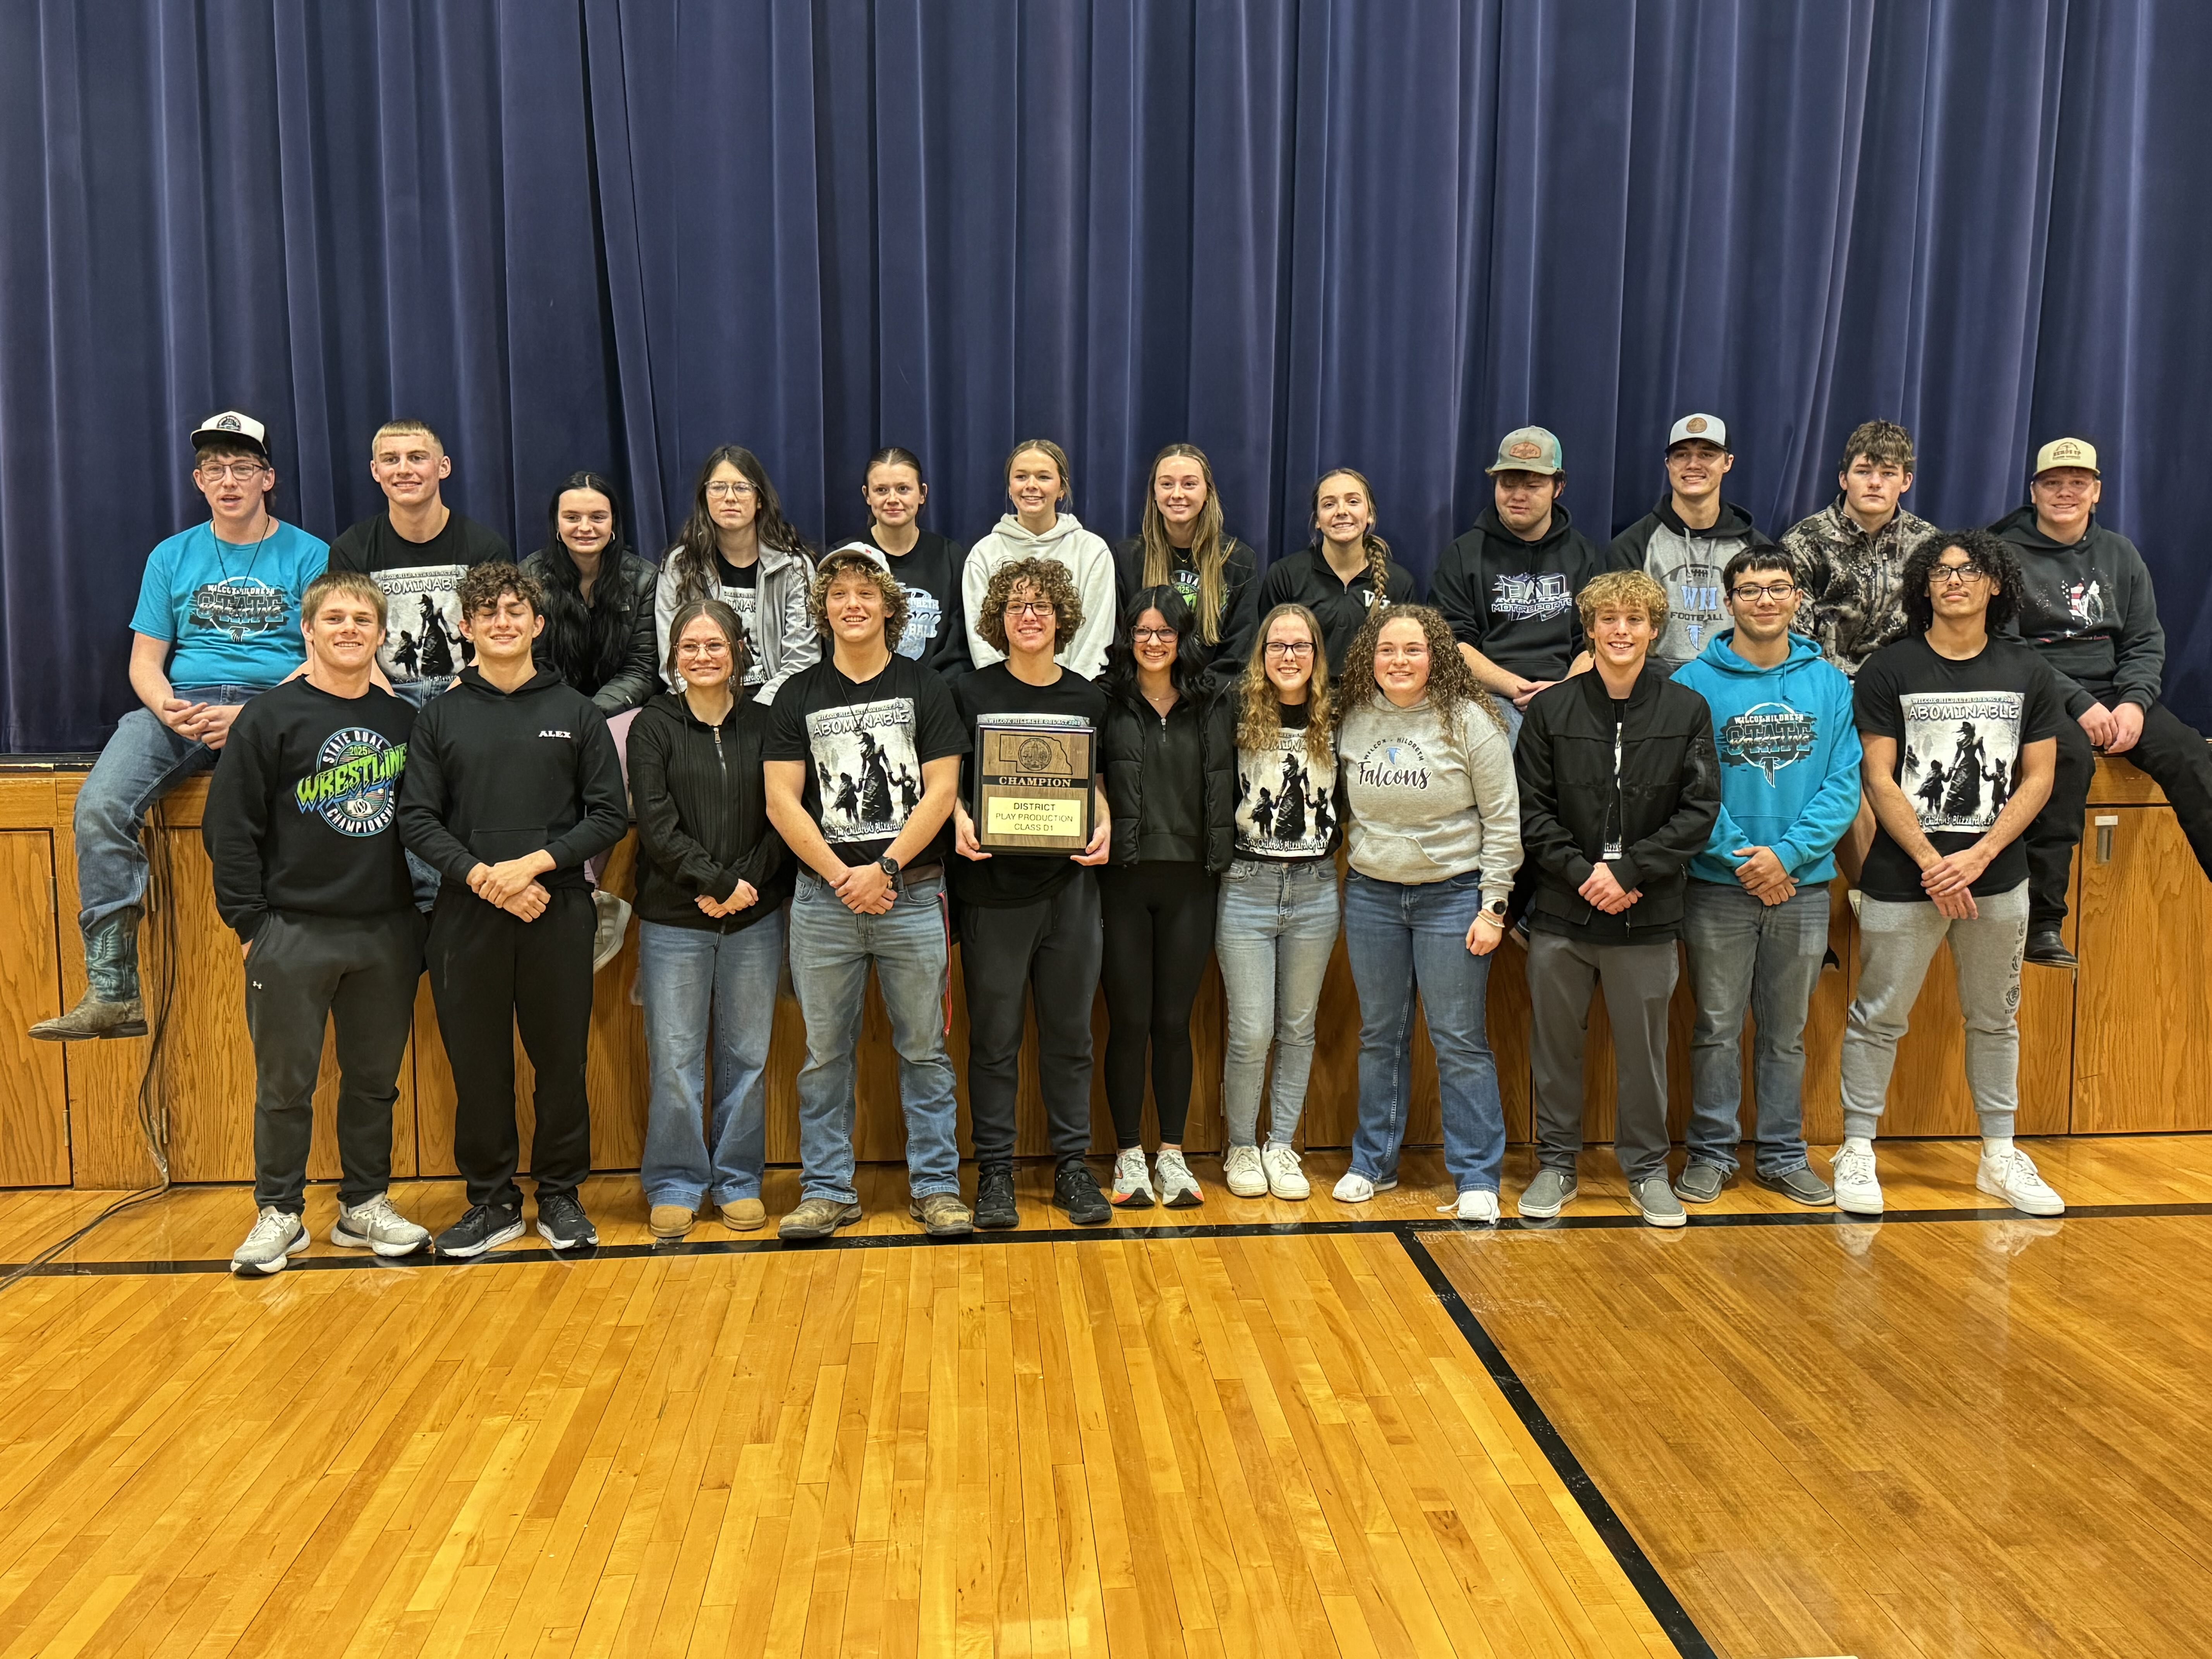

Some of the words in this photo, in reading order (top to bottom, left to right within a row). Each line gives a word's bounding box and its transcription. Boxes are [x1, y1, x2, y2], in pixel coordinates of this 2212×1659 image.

[1180, 572, 1199, 587] DUA
[1680, 586, 1717, 611] WH
[1909, 704, 2019, 720] ABOMINABLE
[539, 730, 571, 738] ALEX
[323, 732, 351, 764] STATE
[354, 730, 384, 750] DUAL
[349, 746, 368, 756] 2025
[1363, 739, 1386, 760] WILCOX
[1396, 737, 1424, 761] HILDRETH
[999, 776, 1072, 787] CHAMPION
[1357, 761, 1432, 789] Falcons
[1013, 802, 1056, 811] DISTRICT
[1018, 814, 1073, 822] PRODUCTION
